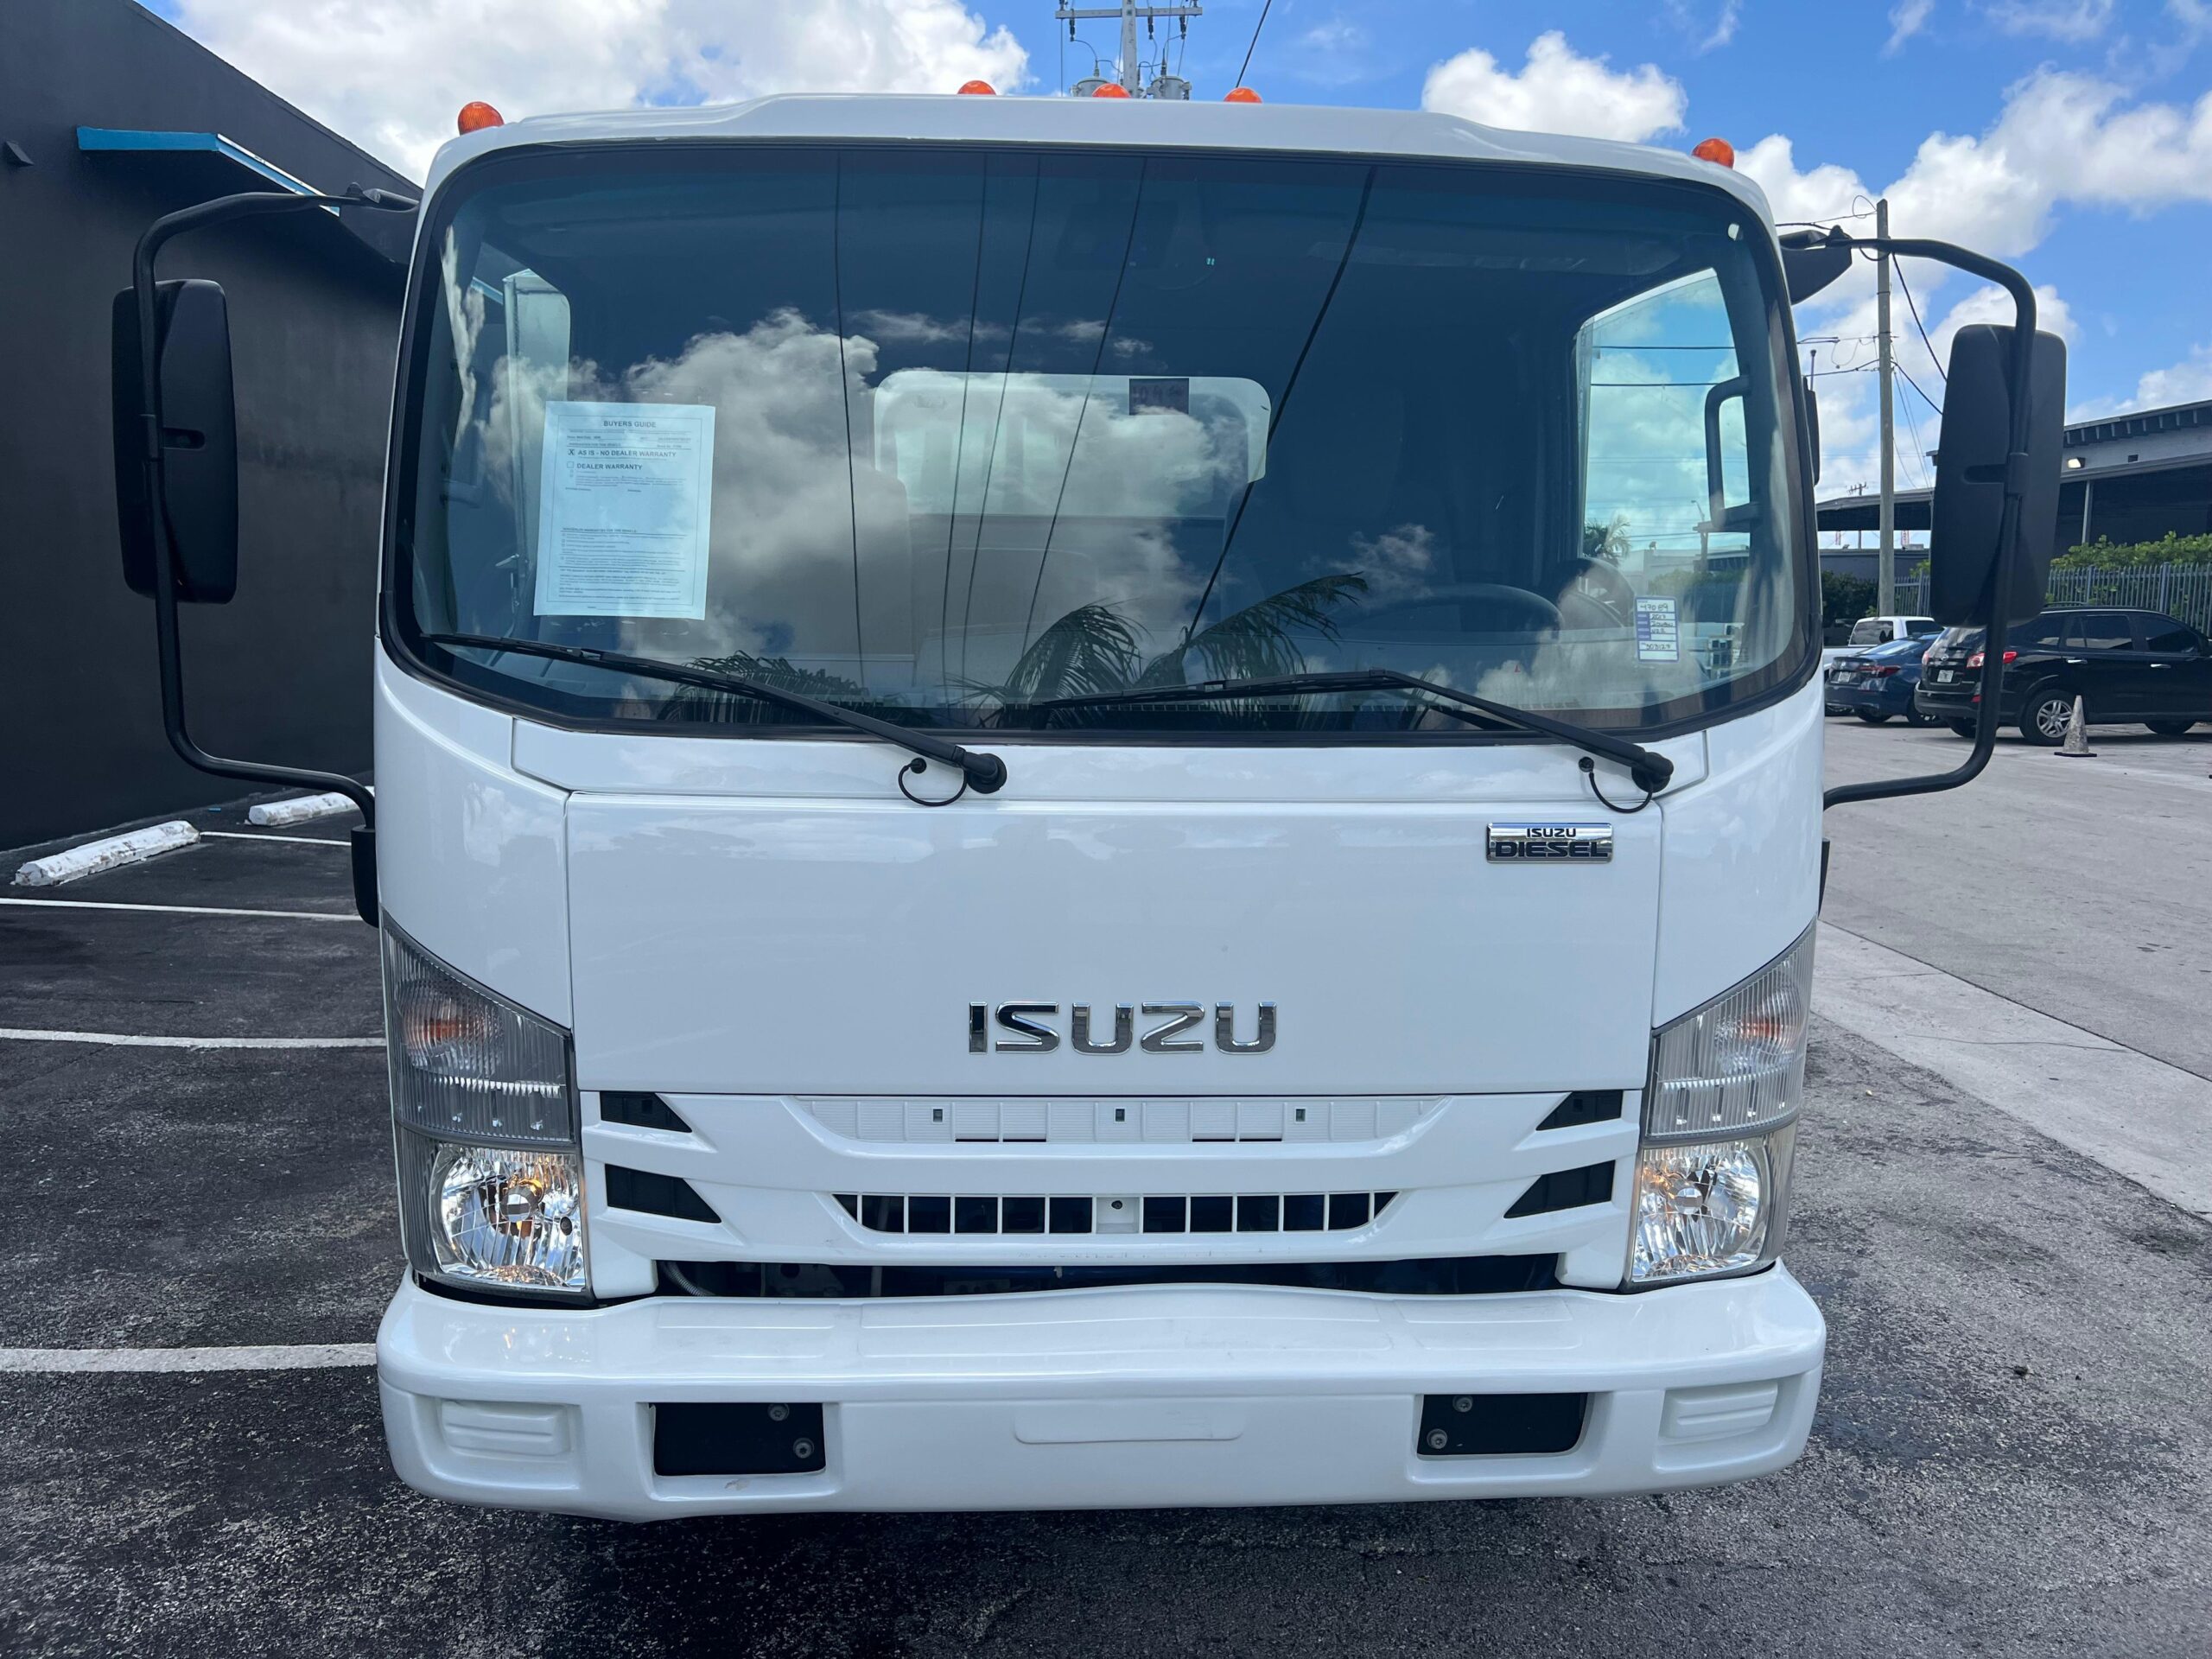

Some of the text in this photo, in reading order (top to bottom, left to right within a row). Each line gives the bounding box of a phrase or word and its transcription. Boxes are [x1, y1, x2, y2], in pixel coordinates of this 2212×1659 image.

[1526, 828, 1577, 838] ISUZU
[1495, 841, 1609, 858] DIESEL
[969, 1001, 1278, 1055] ISUZU
